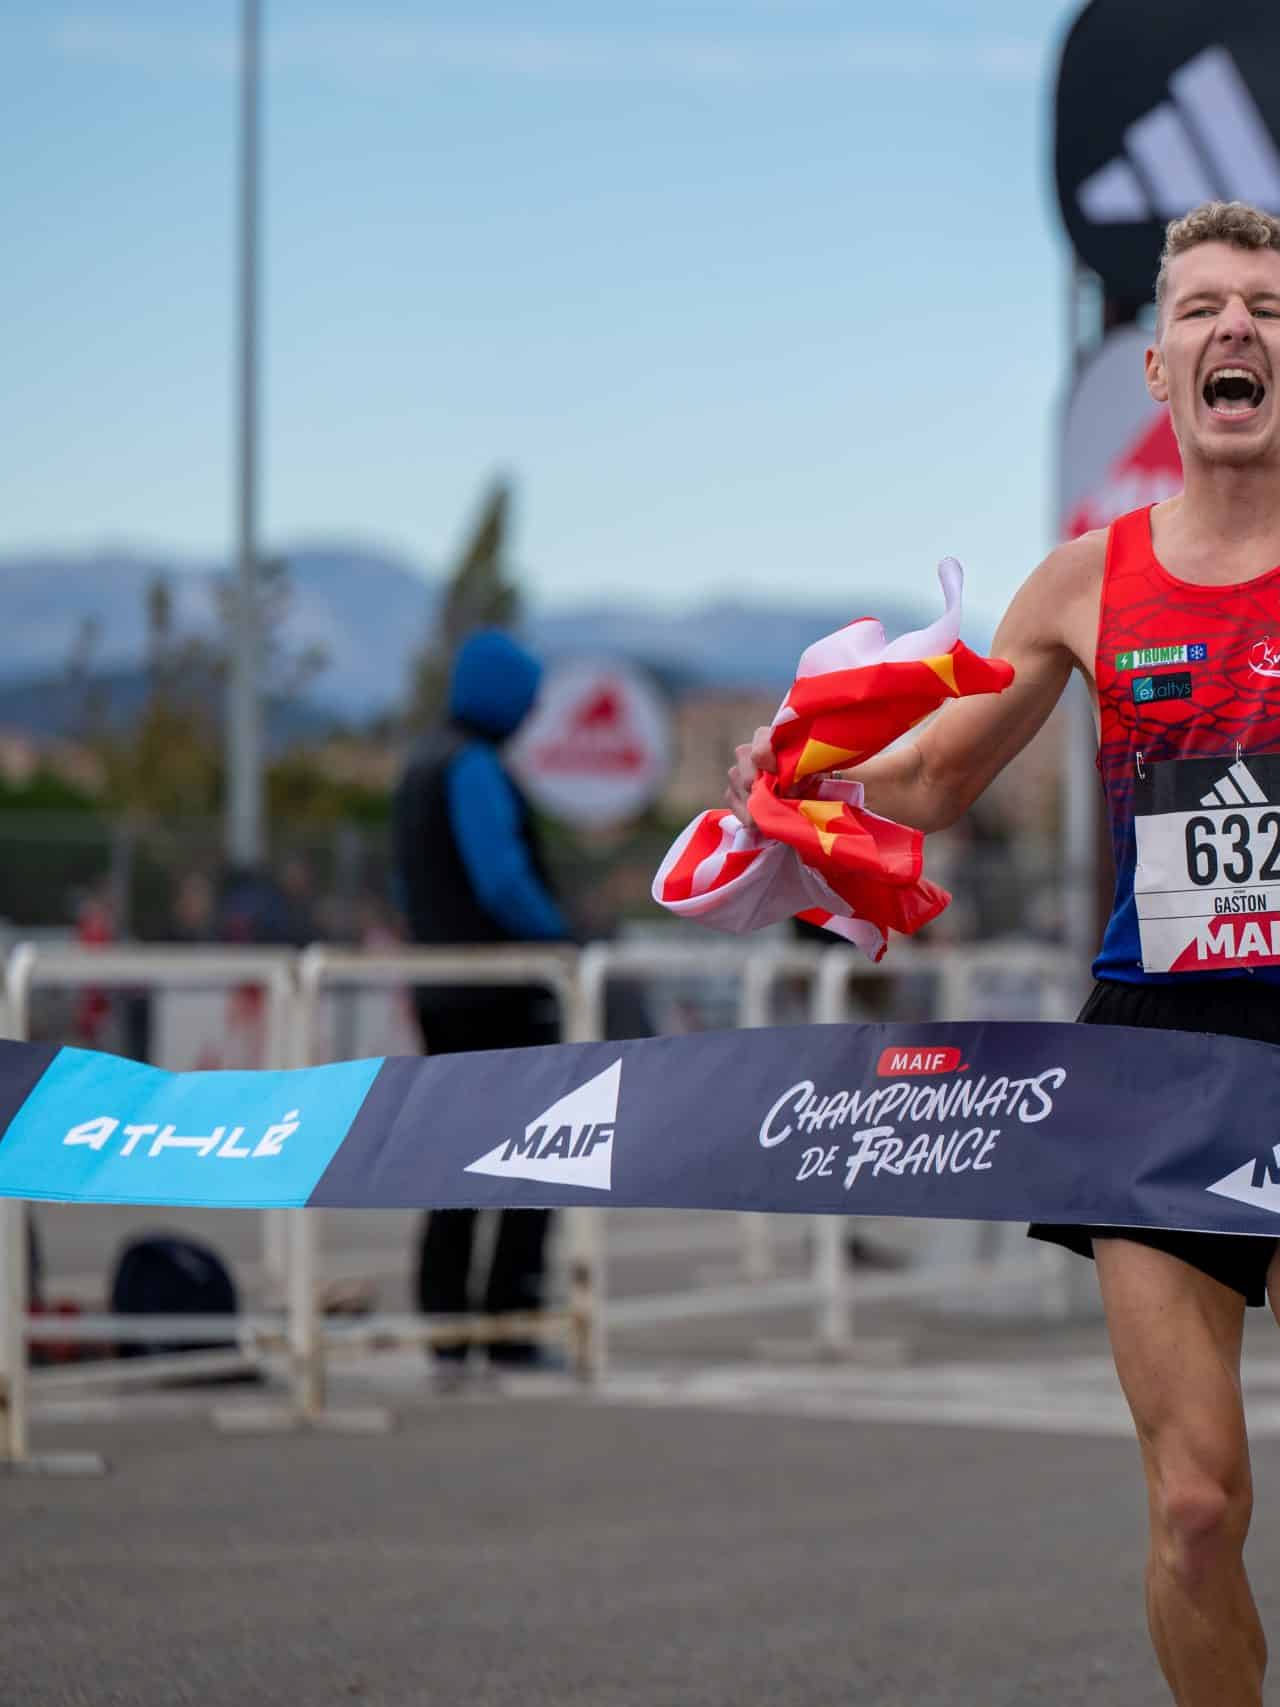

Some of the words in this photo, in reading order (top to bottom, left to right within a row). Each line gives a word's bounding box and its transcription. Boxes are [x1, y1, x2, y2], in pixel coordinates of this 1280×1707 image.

[1136, 647, 1184, 664] TRUMPF
[1140, 681, 1191, 700] exaltys
[1214, 894, 1267, 914] GASTON
[890, 1053, 946, 1071] MAIF
[759, 1067, 1067, 1148] CHAMPIONNATS
[500, 1121, 616, 1162] MAIF
[795, 1145, 840, 1181] DE
[843, 1125, 1001, 1191] FRANCE
